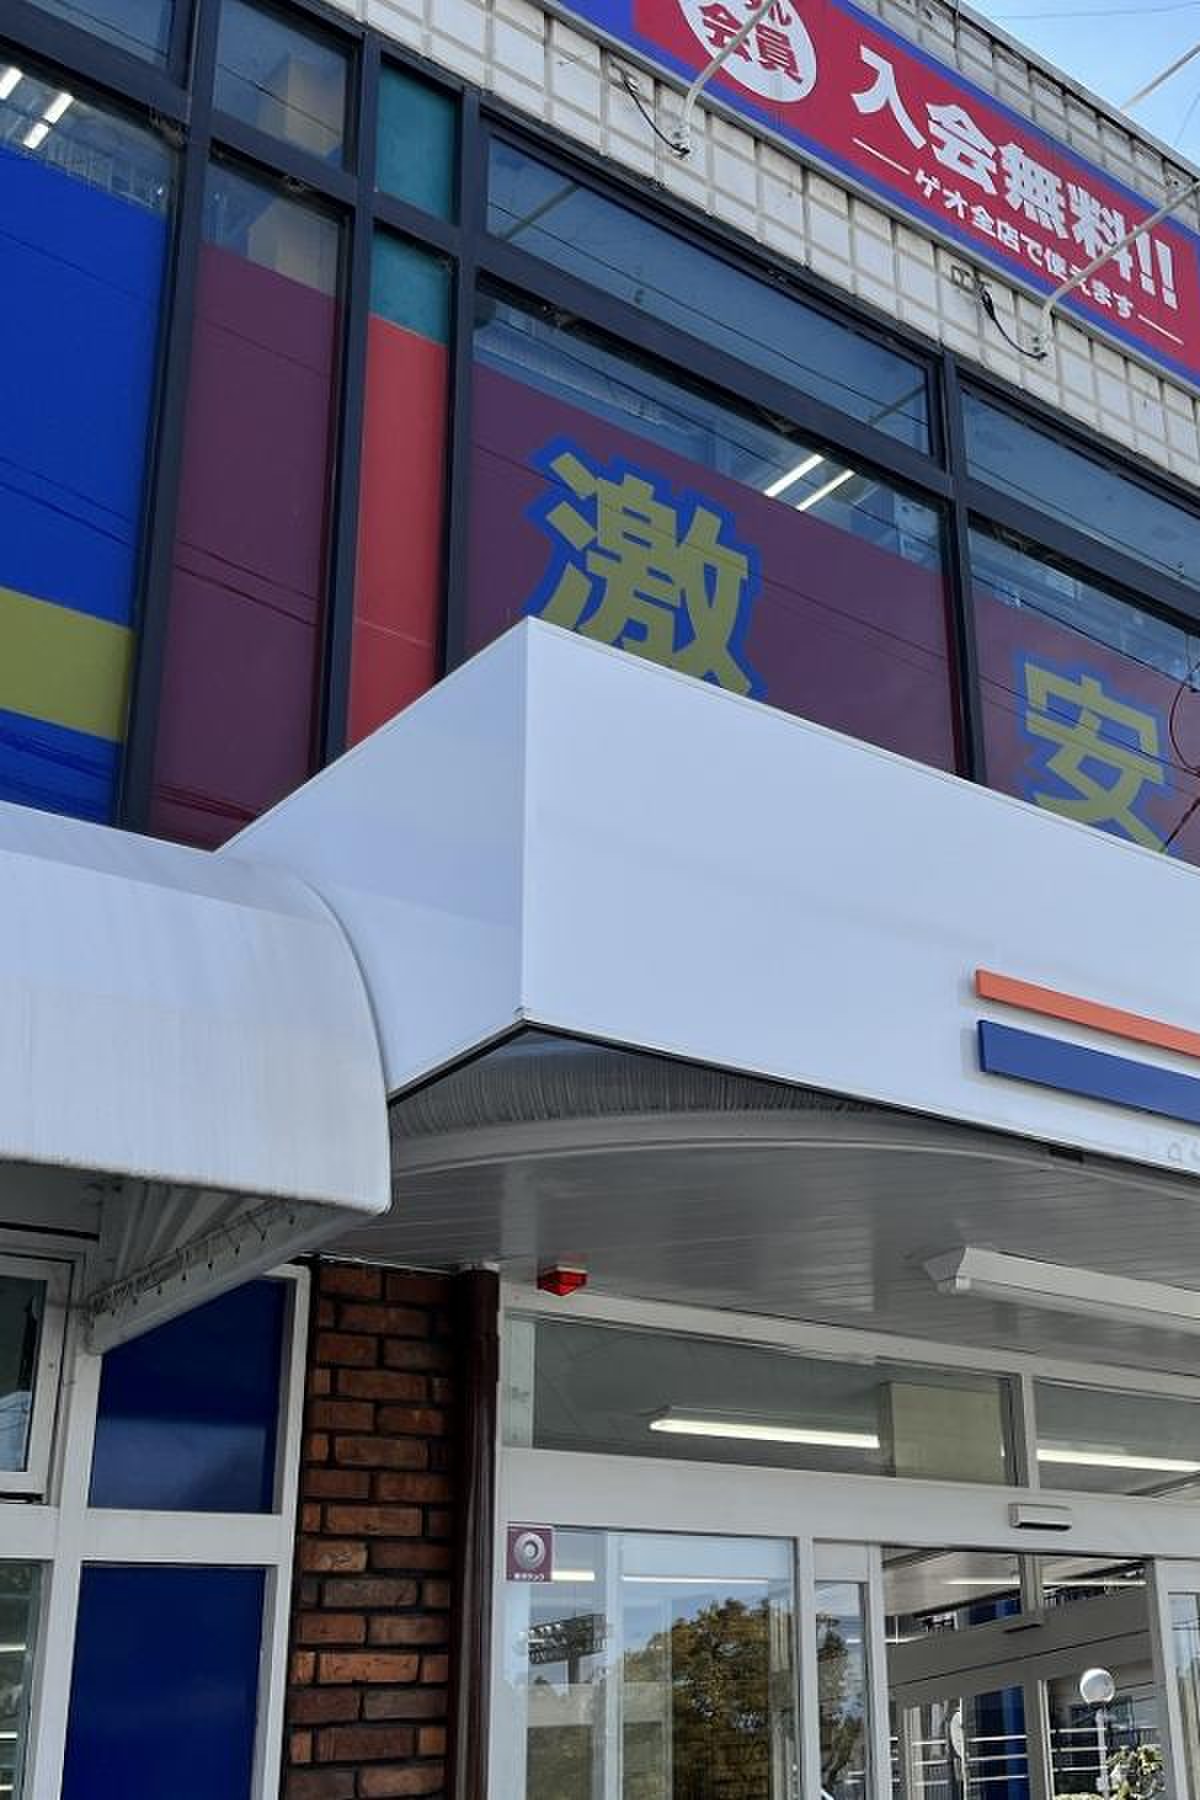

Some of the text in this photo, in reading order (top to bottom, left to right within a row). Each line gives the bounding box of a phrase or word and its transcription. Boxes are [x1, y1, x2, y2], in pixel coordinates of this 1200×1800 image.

[699, 3, 803, 84] 会員
[851, 45, 1178, 311] 入会無料!!
